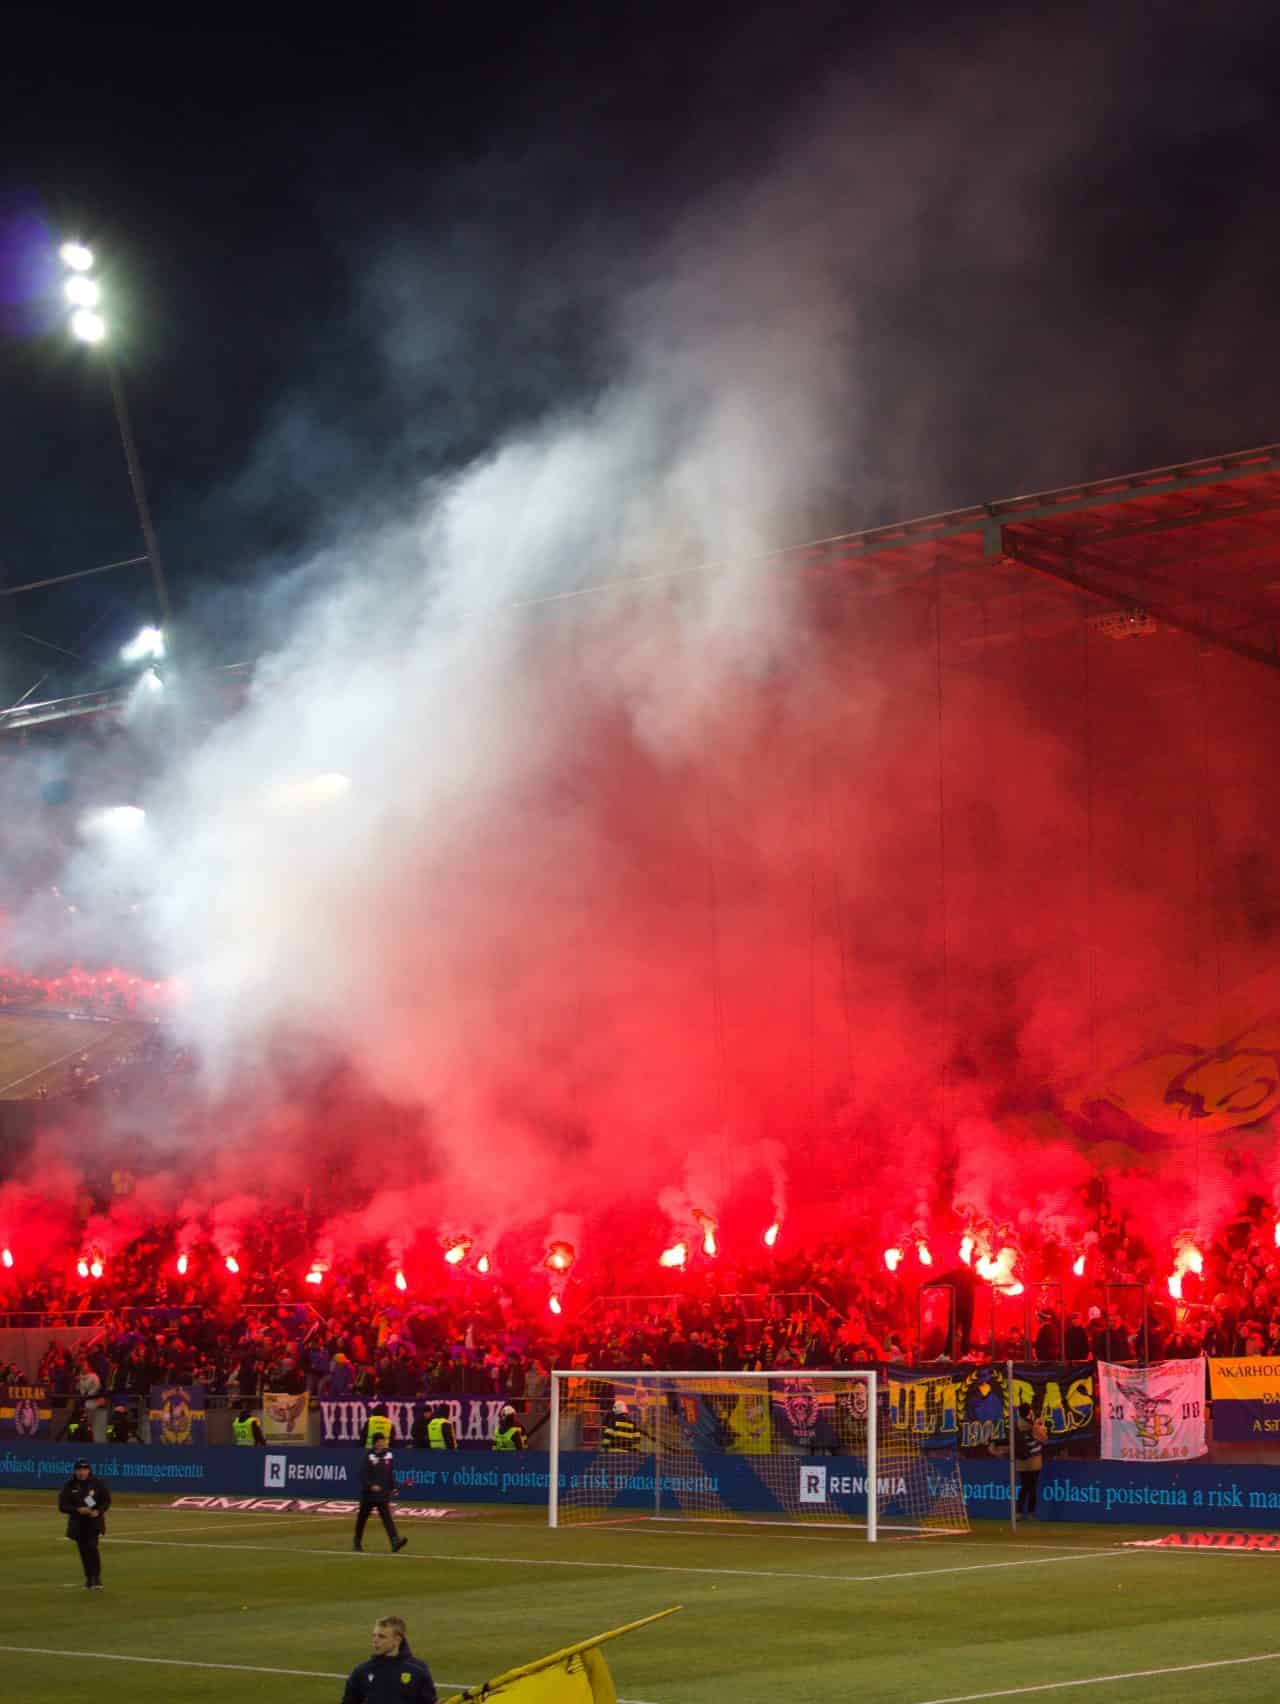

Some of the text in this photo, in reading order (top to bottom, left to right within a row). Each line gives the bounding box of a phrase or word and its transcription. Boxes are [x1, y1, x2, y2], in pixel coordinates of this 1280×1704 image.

[1253, 1418, 1263, 1433] A
[288, 1465, 348, 1481] RENOMIA
[453, 1466, 499, 1487] oblasti
[1043, 1480, 1101, 1503] oblasti
[1105, 1482, 1187, 1511] poistenia
[1193, 1490, 1204, 1506] a
[1207, 1484, 1244, 1508] risk
